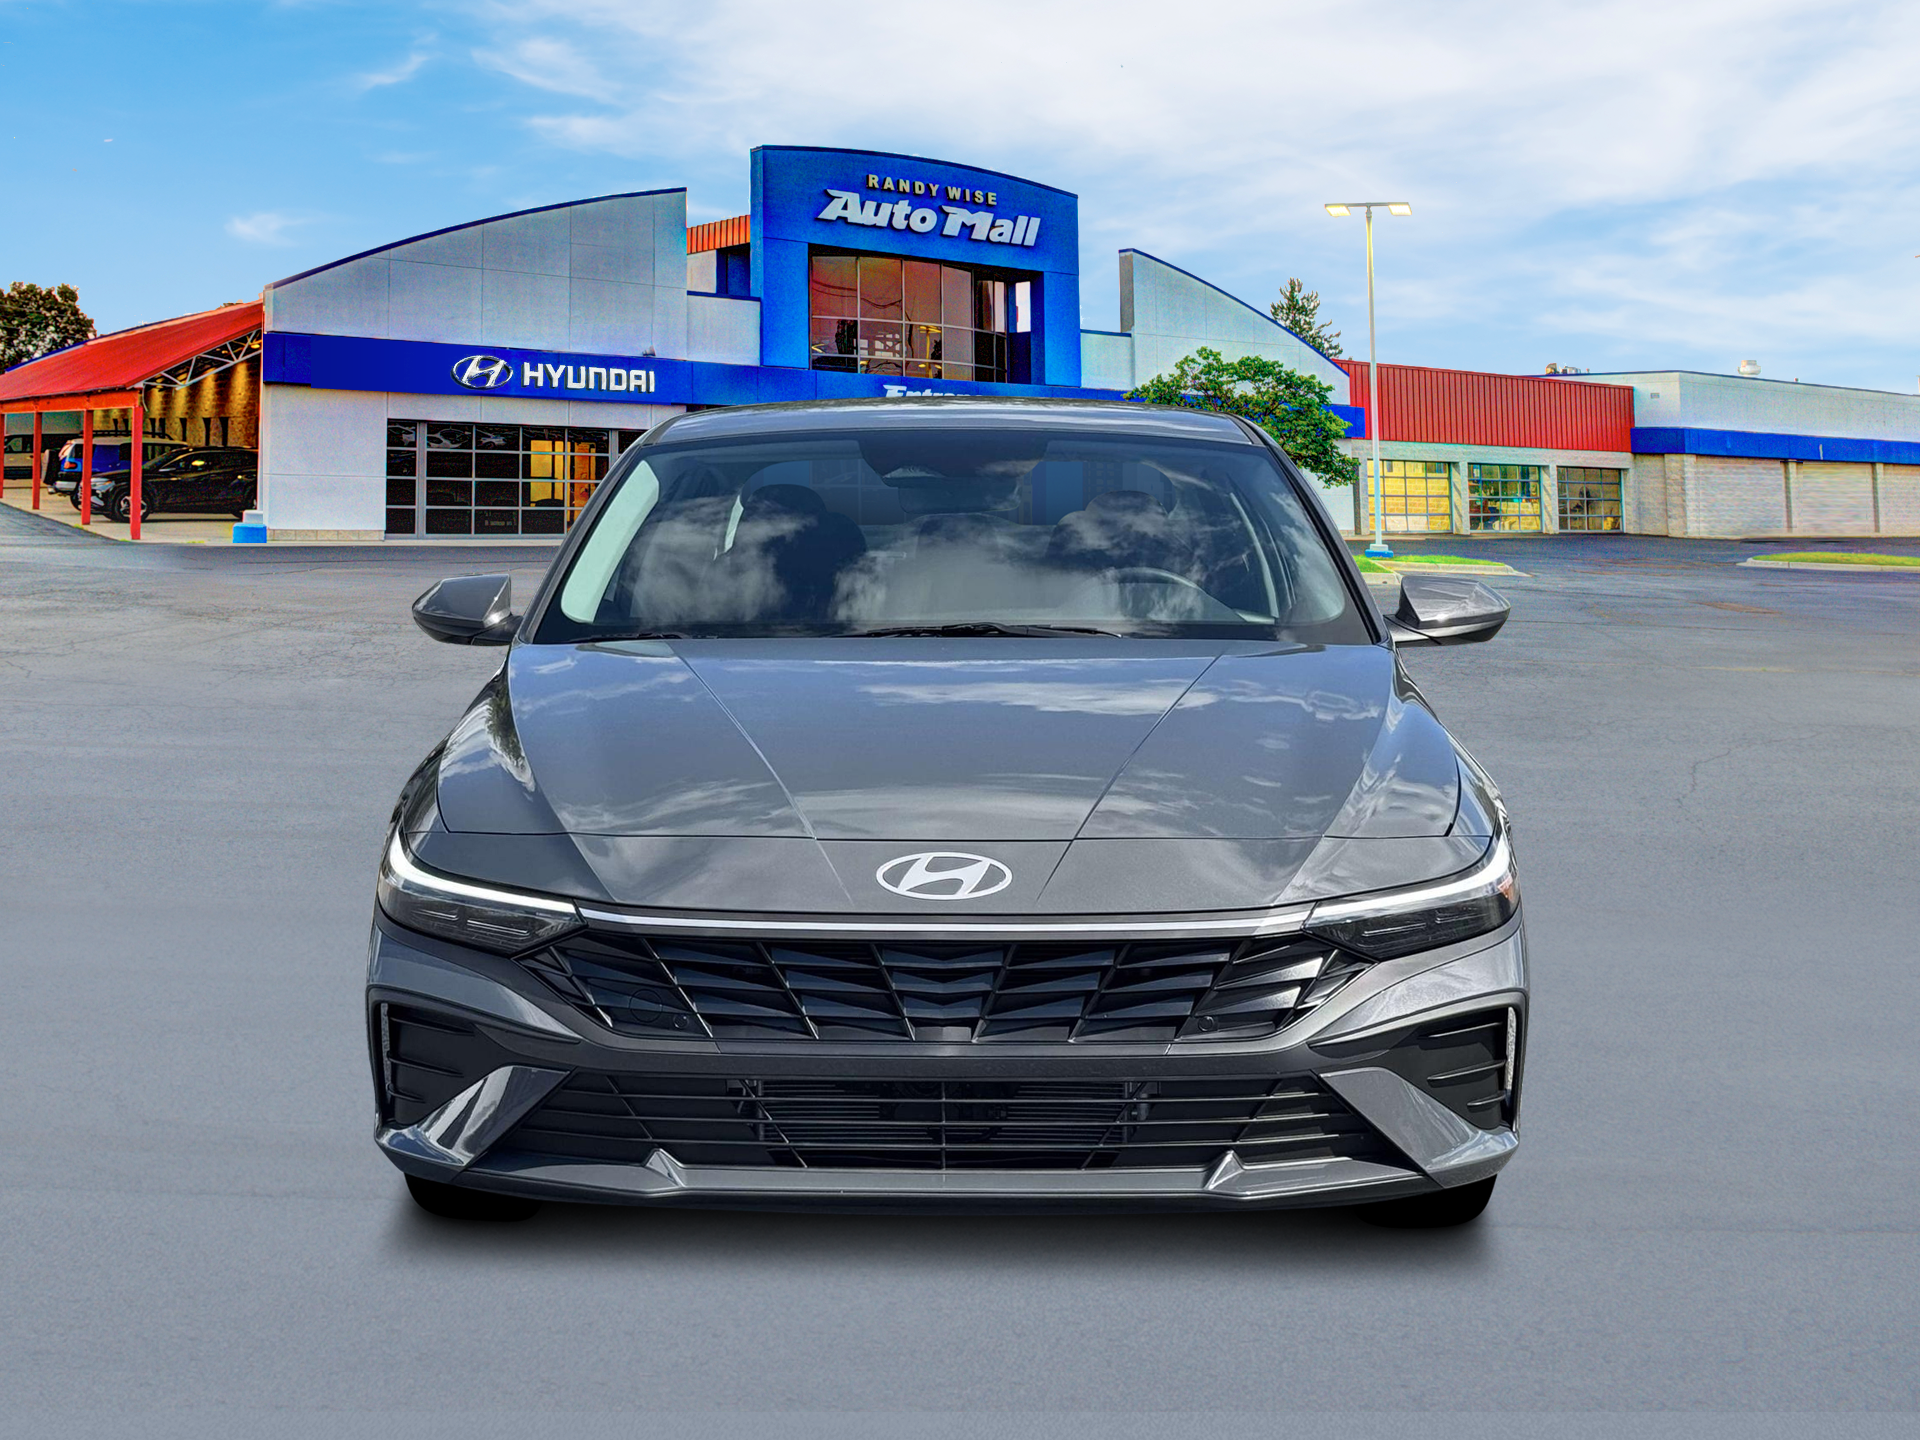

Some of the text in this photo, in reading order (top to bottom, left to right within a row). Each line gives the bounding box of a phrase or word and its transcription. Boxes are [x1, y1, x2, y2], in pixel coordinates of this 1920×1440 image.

[867, 174, 997, 206] RANDY WISE
[817, 189, 1041, 246] Auto Mall
[523, 361, 655, 393] HYUNDAI
